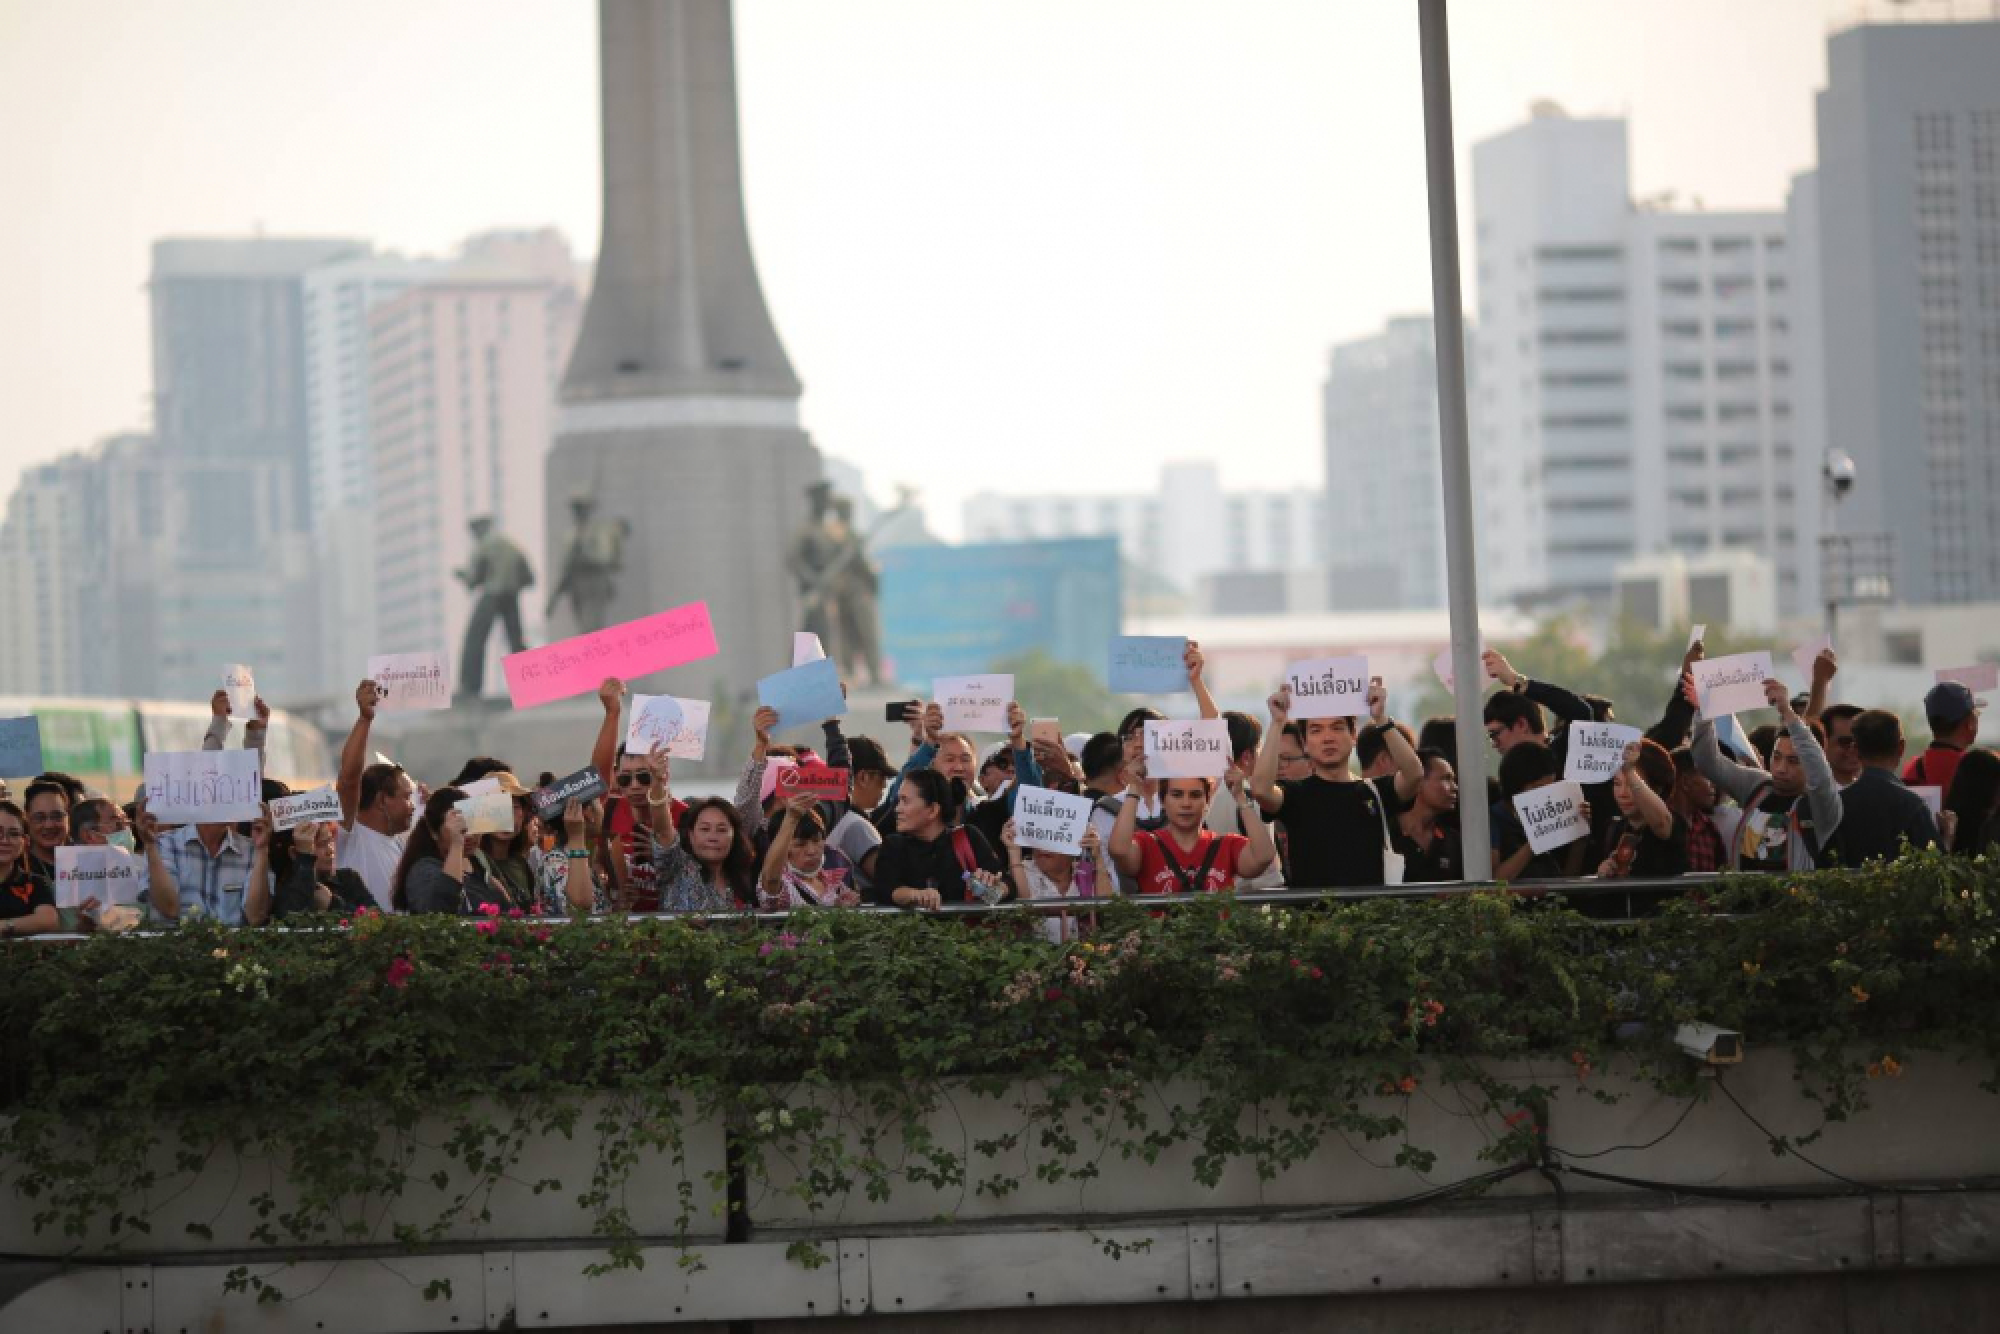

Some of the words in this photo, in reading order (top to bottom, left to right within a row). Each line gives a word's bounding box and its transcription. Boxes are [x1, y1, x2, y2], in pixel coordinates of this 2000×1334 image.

[1291, 667, 1362, 697] ไม่เลื่อน
[1150, 728, 1220, 752] ไม่เลื่อน
[1578, 728, 1625, 749] ไม่เลื่อน
[1021, 796, 1077, 820] ไม่เลื่อน
[1521, 796, 1572, 826] ไม่เลื่อน
[1020, 822, 1072, 843] เลือกตั้ง
